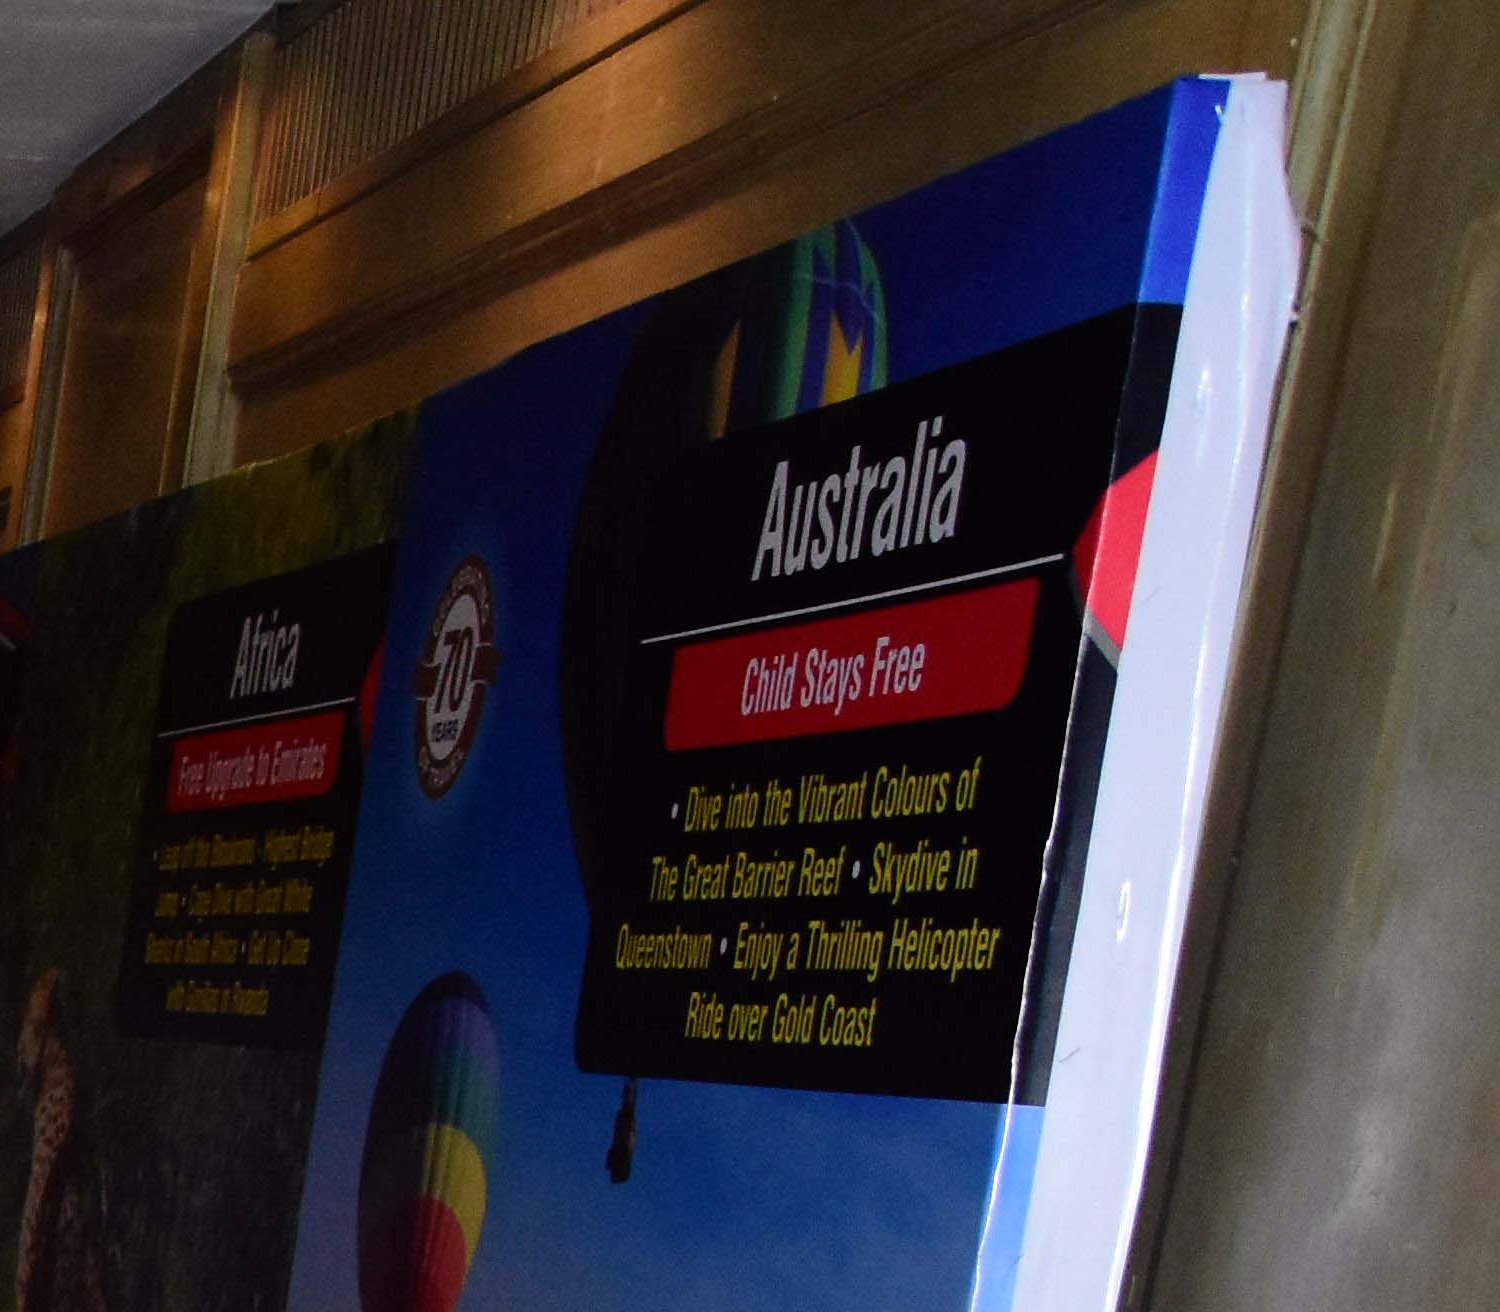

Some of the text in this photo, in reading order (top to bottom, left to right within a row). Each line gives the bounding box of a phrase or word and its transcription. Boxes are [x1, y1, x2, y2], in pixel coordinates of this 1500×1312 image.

[751, 414, 968, 582] Australia
[230, 609, 301, 700] Africa
[434, 626, 475, 714] 70
[741, 636, 925, 716] Child Stays Free
[178, 755, 204, 797] Free
[205, 744, 254, 801] Upgrade
[684, 755, 983, 833] Dive into the Vibrant Colours of
[651, 841, 979, 905] The Great Barrier Reef Skydive in
[616, 916, 1002, 983] Queenstown Enjoy a Thrilling Helicopter
[685, 992, 877, 1047] Ride over Gold Coast
